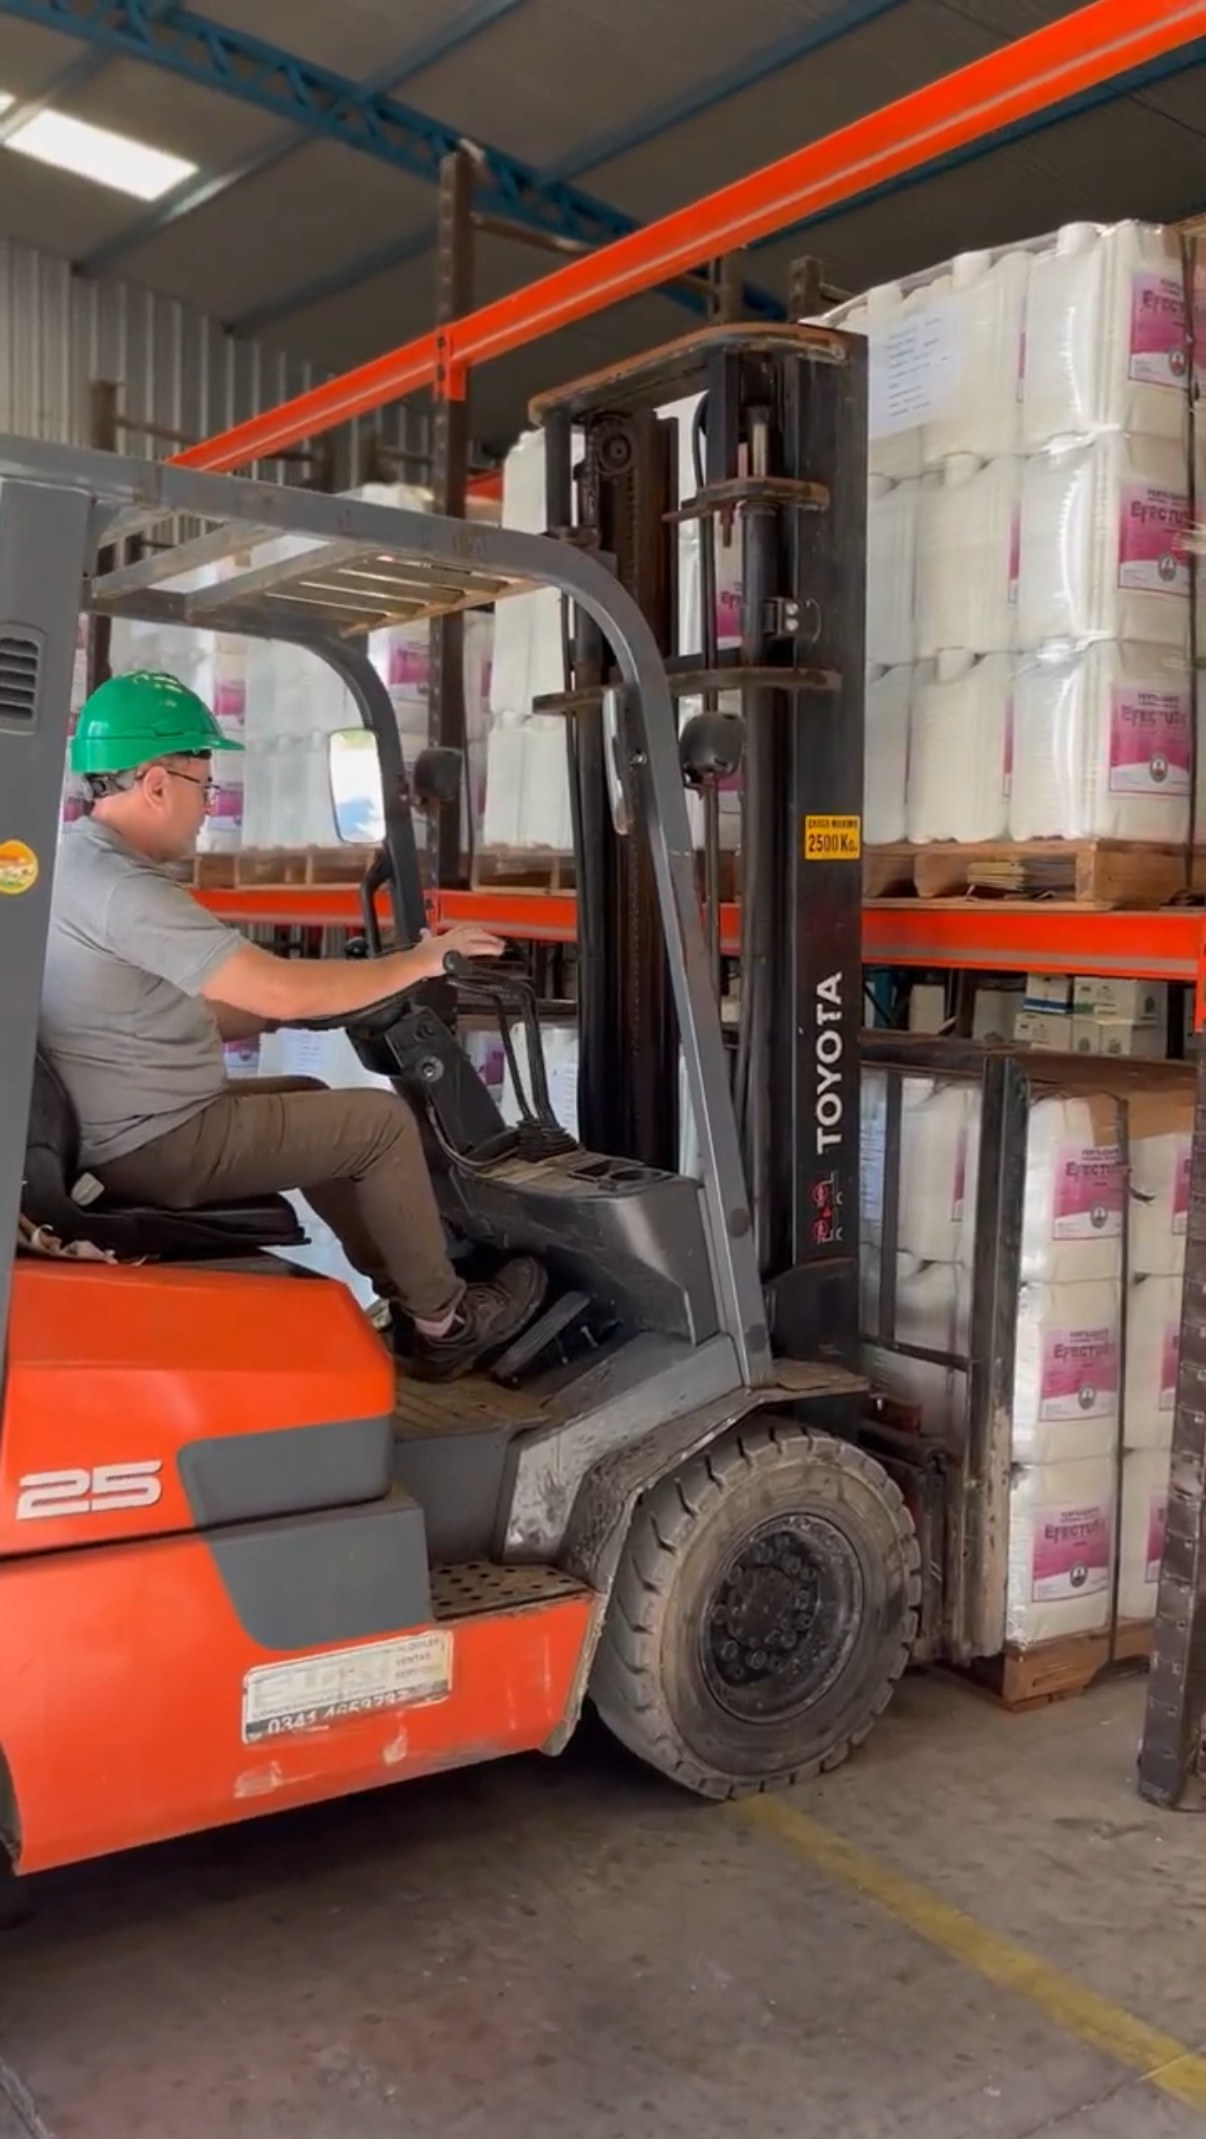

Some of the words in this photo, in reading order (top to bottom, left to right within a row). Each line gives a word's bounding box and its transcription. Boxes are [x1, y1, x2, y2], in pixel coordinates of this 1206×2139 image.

[816, 971, 843, 1155] TOYOTA
[16, 1460, 162, 1520] 25
[395, 1651, 431, 1667] VENTAS
